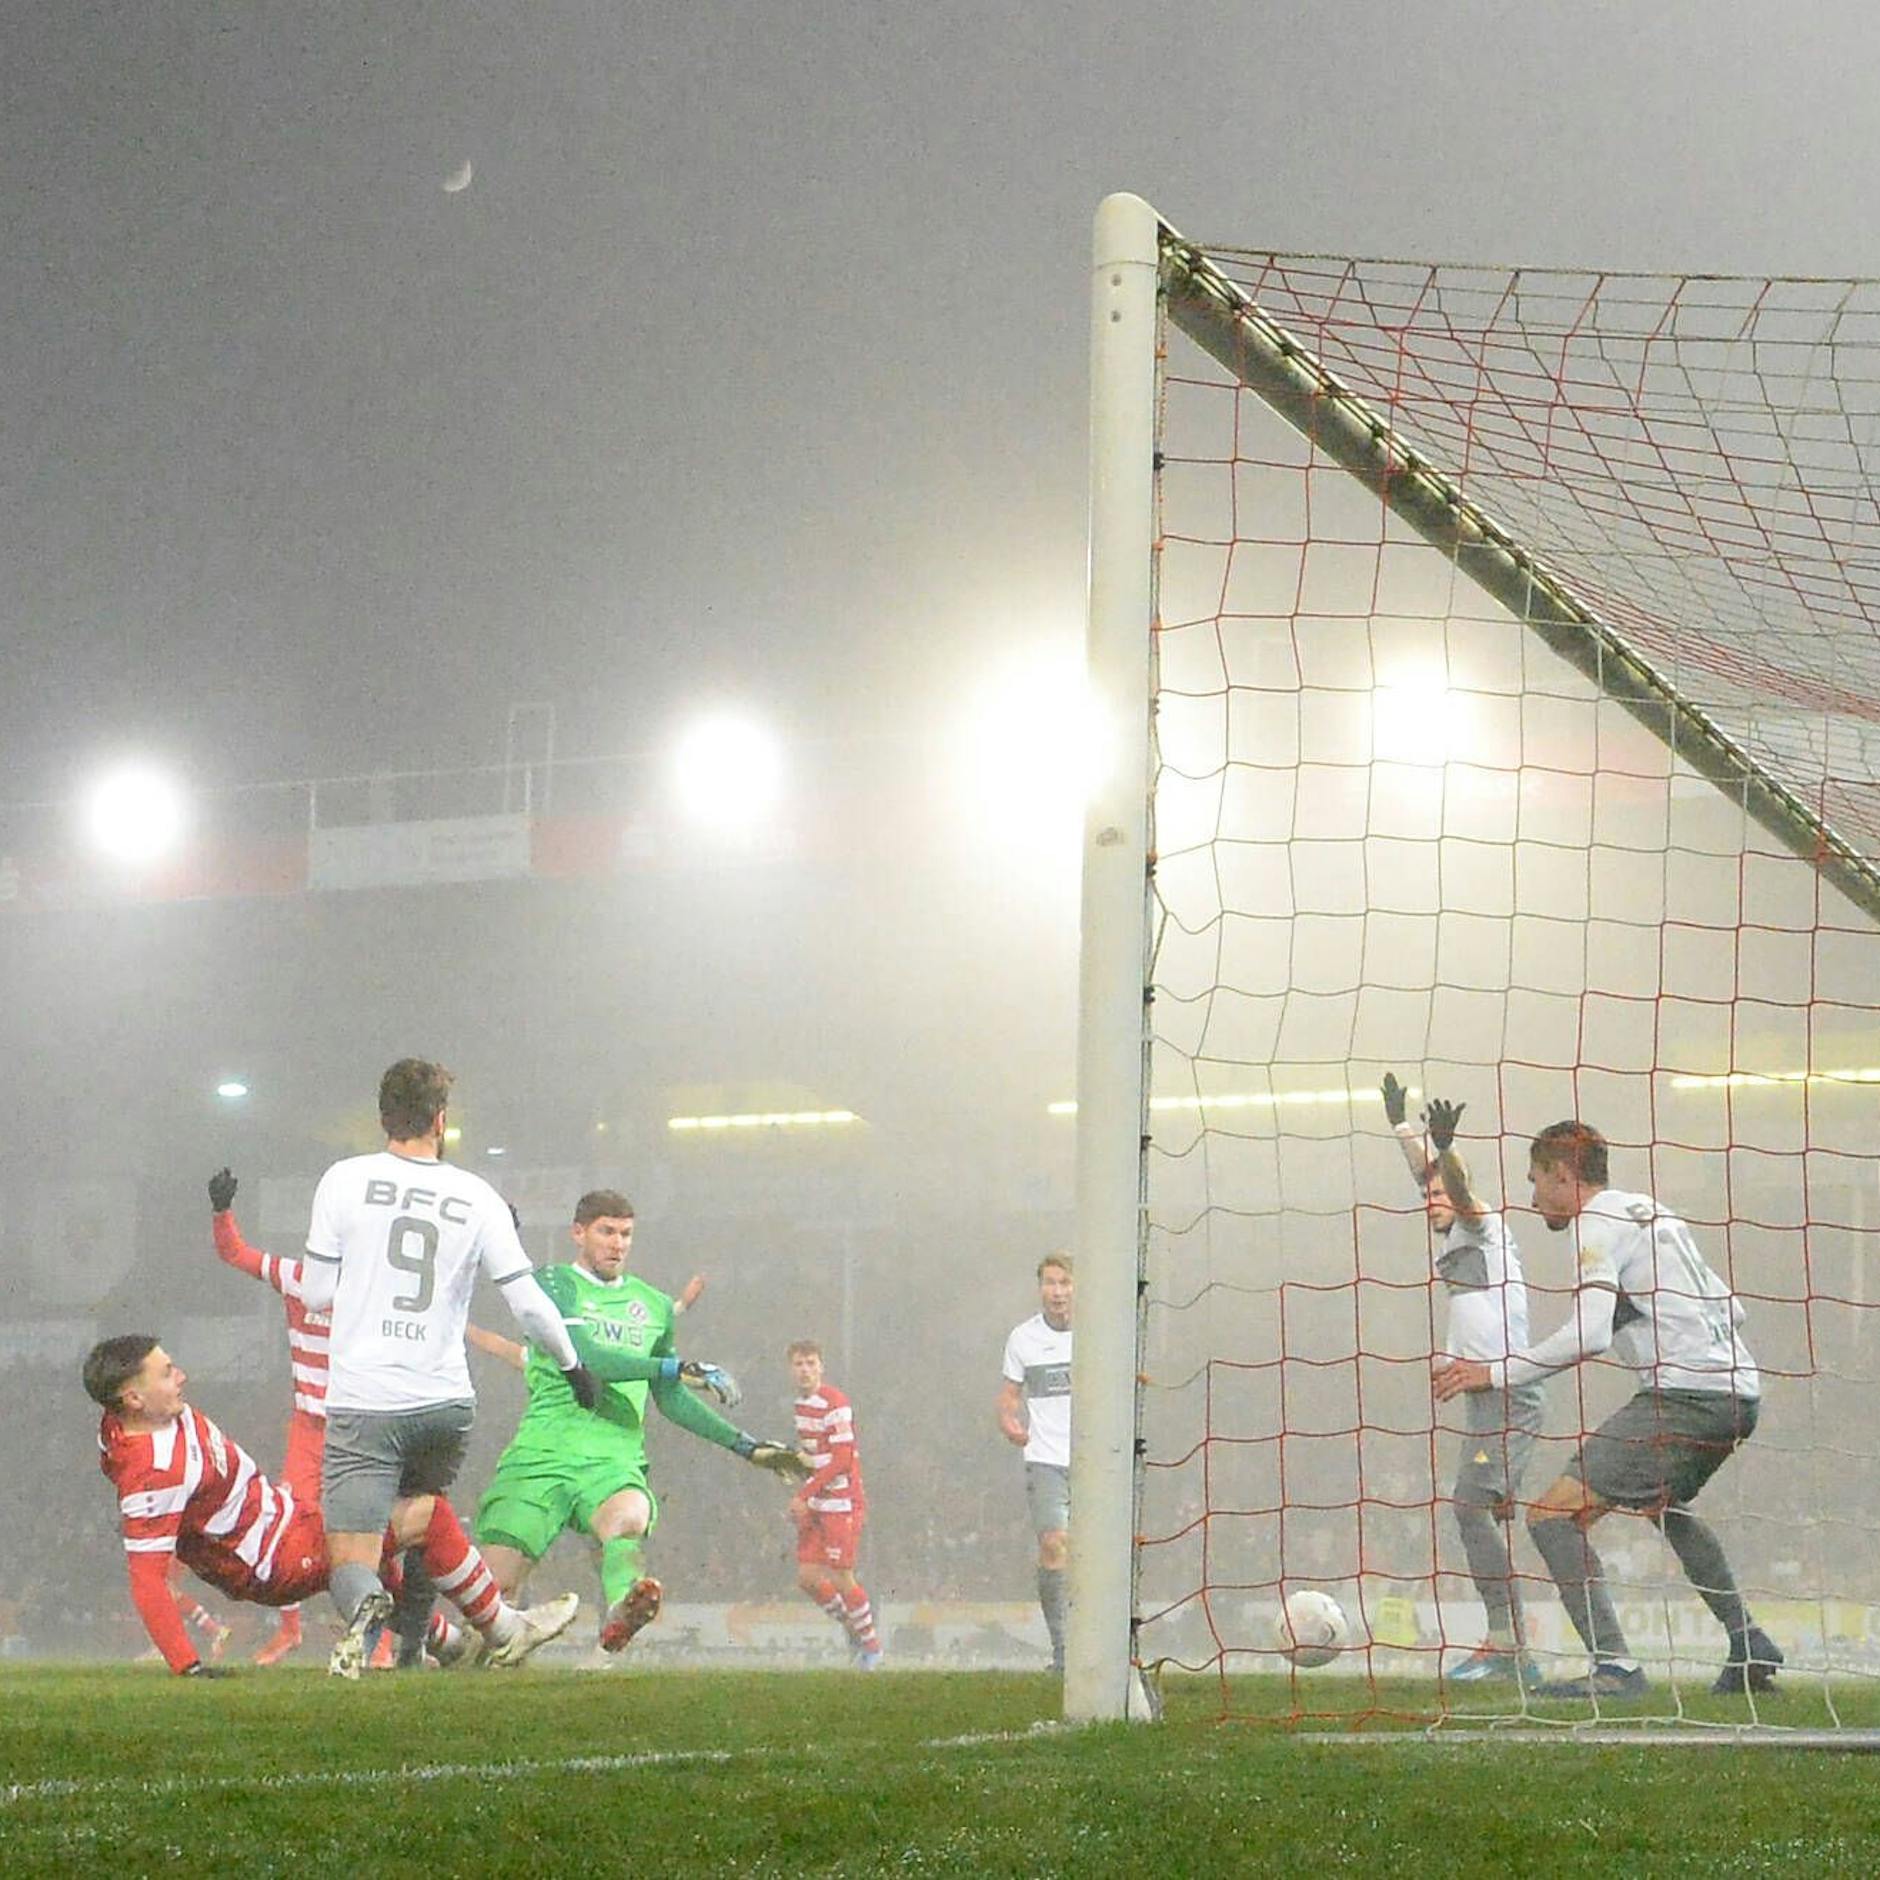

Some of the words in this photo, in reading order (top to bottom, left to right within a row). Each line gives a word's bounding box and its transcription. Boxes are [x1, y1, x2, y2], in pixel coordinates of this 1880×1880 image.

[365, 1179, 473, 1225] BFC
[387, 1216, 439, 1313] 9
[382, 1319, 427, 1342] BECK
